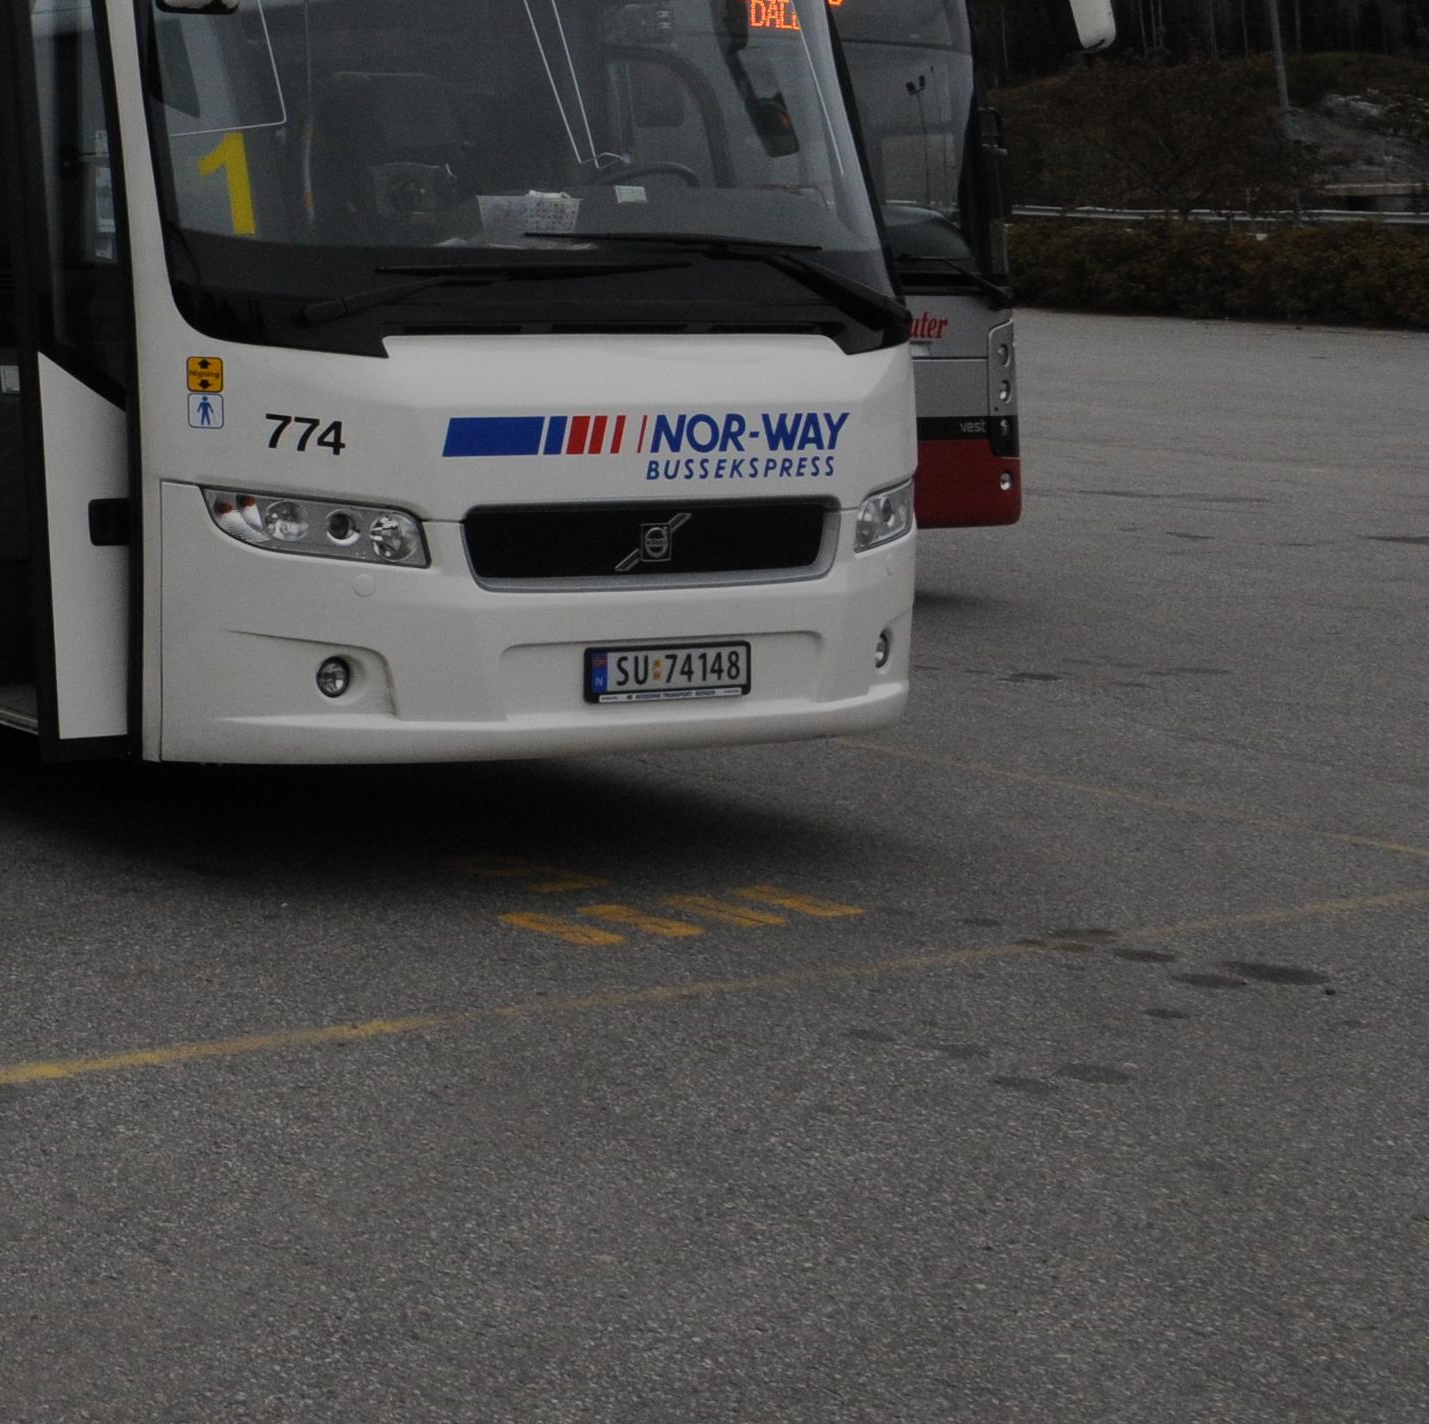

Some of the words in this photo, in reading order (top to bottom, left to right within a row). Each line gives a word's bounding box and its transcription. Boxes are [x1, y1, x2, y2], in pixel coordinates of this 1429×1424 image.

[197, 131, 257, 235] 1
[265, 414, 346, 456] 774
[650, 412, 850, 453] NOR-WAY
[646, 455, 835, 481] BUSSEKSPRESS
[595, 676, 603, 687] N
[616, 654, 649, 686] SU
[664, 650, 741, 684] 74148
